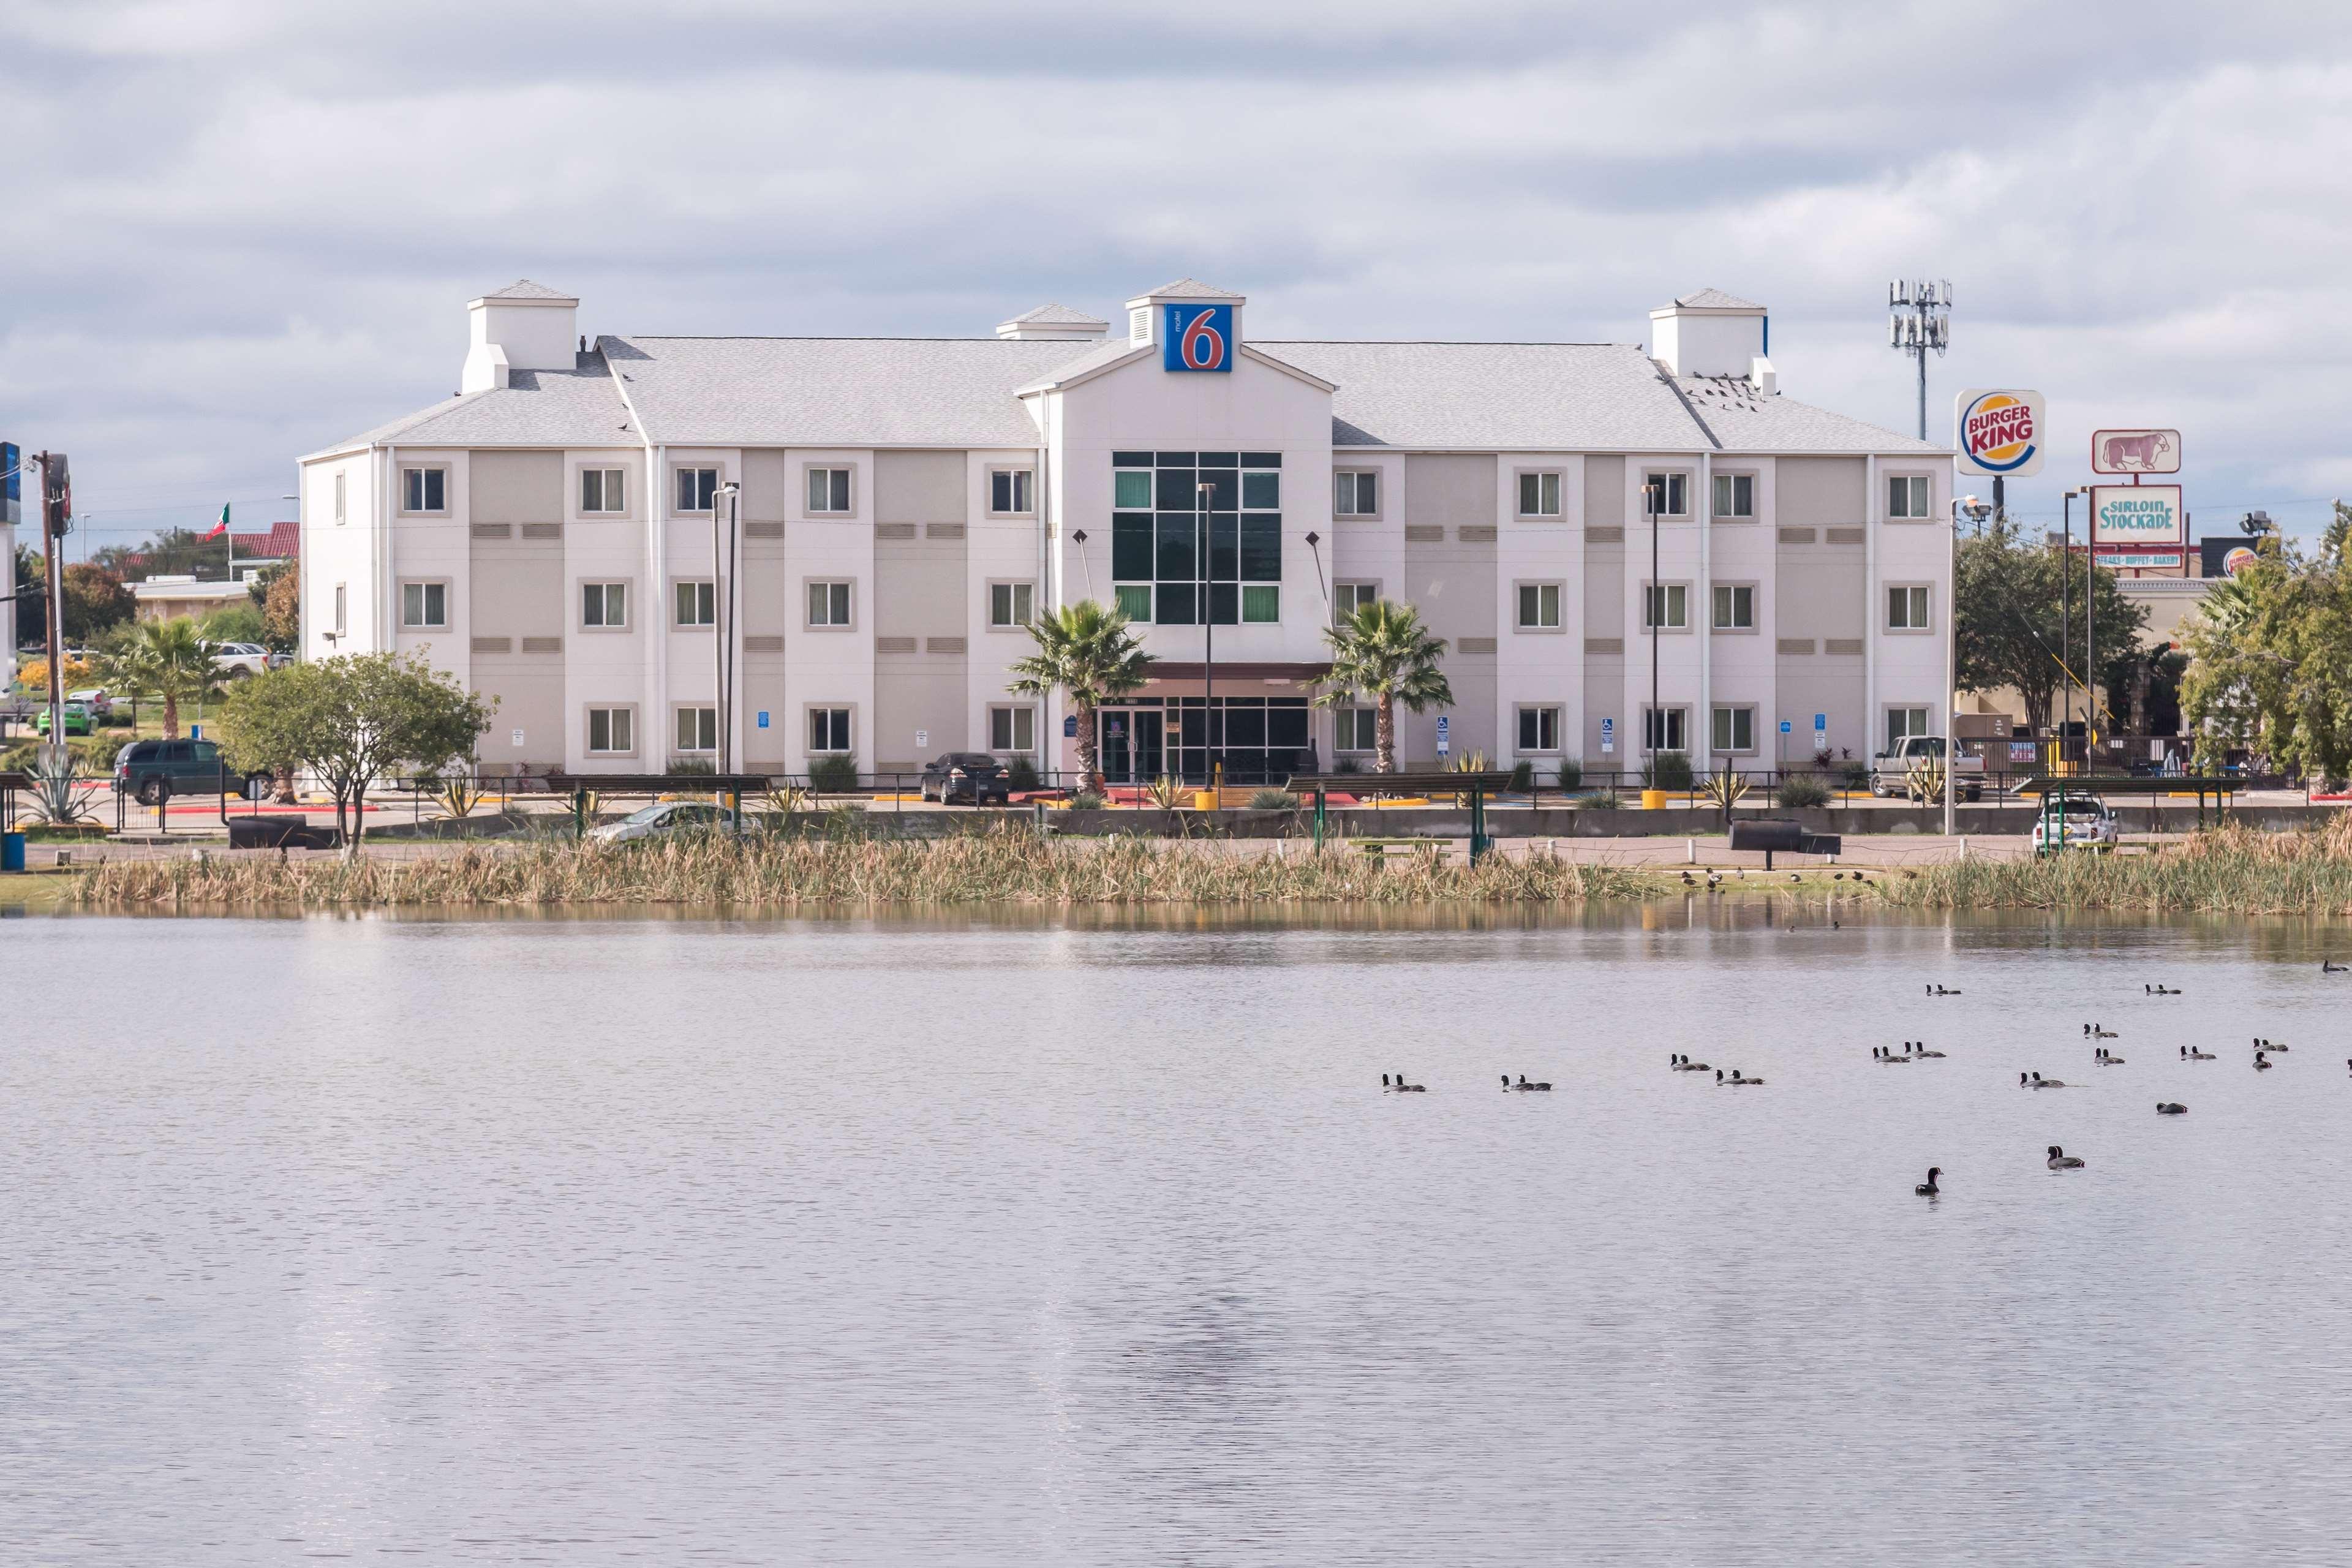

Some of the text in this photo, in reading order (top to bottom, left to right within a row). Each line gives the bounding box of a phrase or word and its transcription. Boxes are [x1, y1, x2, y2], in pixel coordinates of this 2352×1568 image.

[1181, 308, 1224, 369] 6
[1969, 405, 2030, 434] BURGER
[1972, 419, 2033, 454] KING
[2125, 556, 2149, 565] BUFFET
[2154, 556, 2179, 565] BAKERY
